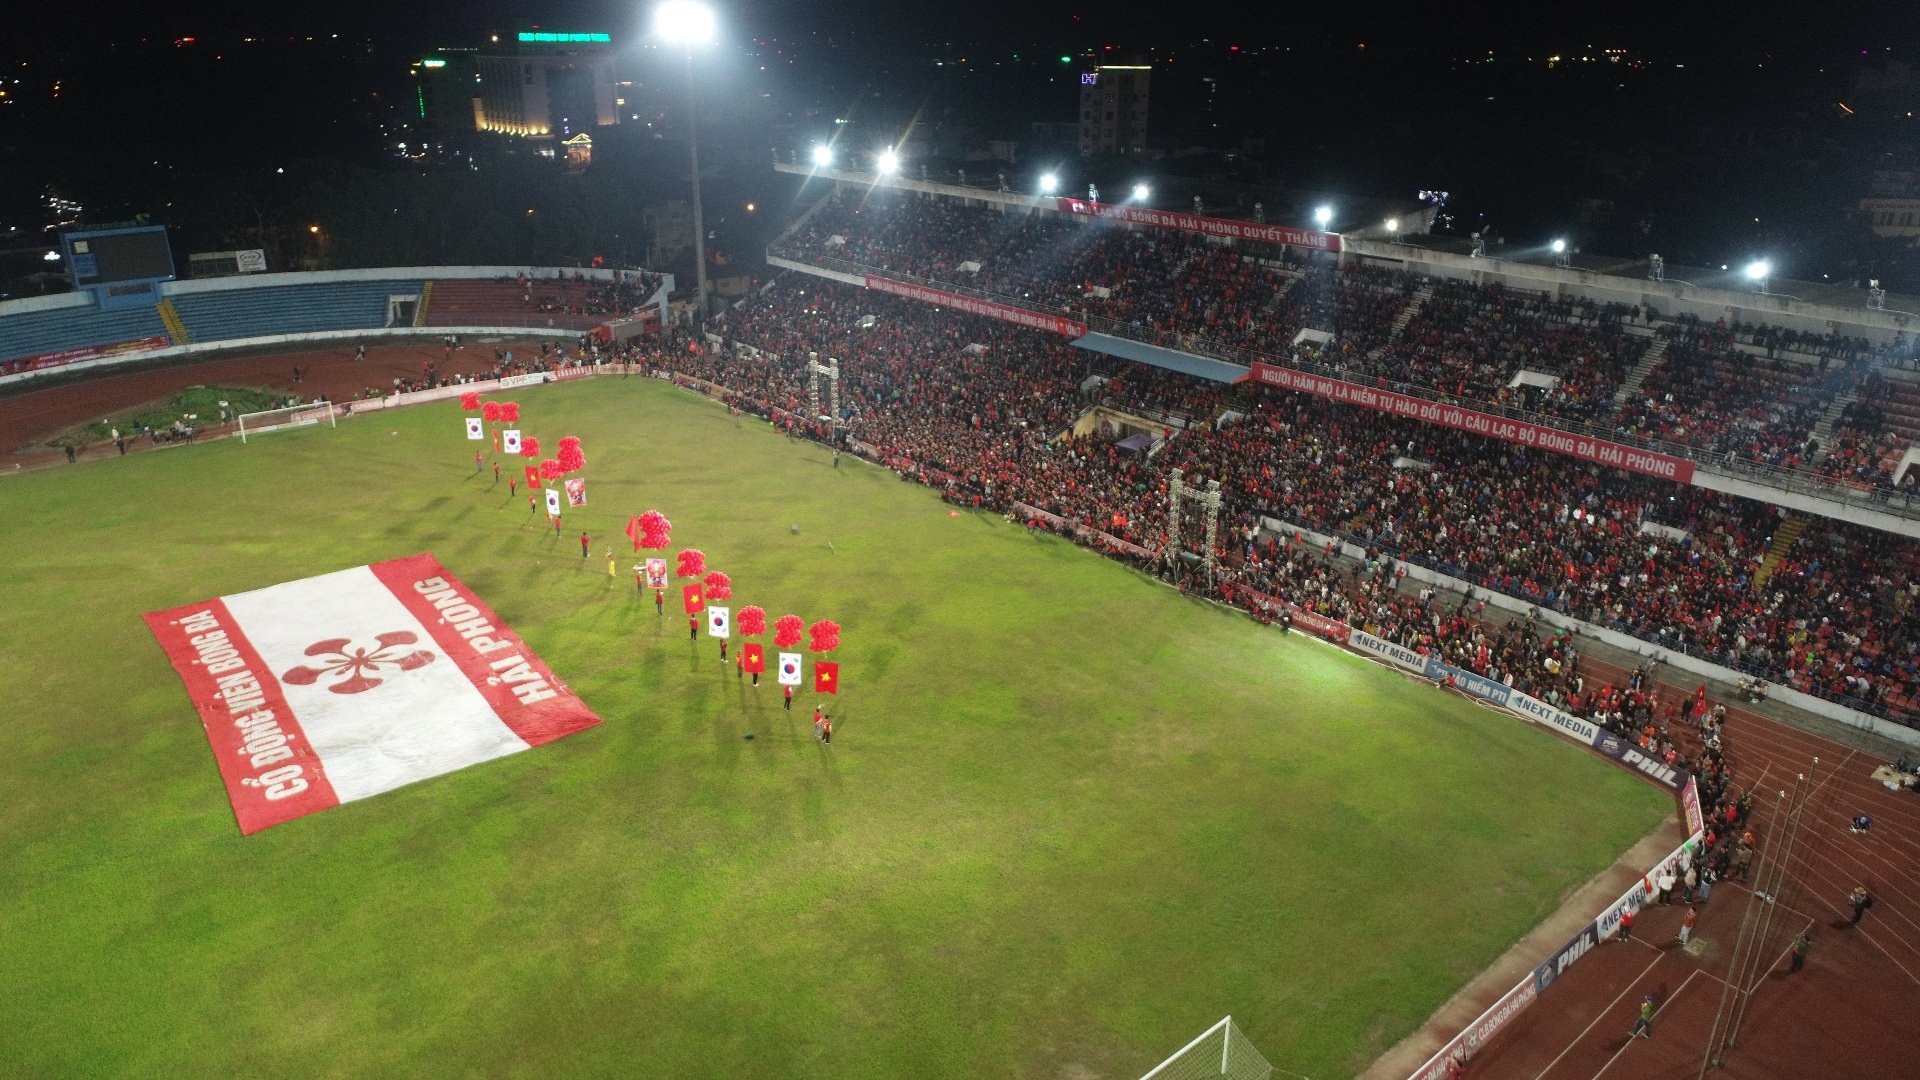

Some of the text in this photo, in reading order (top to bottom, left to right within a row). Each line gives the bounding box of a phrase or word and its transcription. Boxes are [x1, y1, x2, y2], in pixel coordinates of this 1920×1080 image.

[1094, 206, 1112, 218] LẠC
[1115, 208, 1128, 220] BỘ
[1132, 210, 1159, 224] BÓNG
[1161, 213, 1177, 226] ĐÁ
[1180, 216, 1198, 229] HẢI
[1201, 221, 1240, 235] PHÒNG
[1243, 226, 1281, 241] QUYẾT
[1285, 230, 1327, 247] THẮNG
[921, 291, 940, 303] CHUNG
[940, 295, 950, 305] TAY
[987, 306, 1001, 318] PHÁT
[1003, 308, 1019, 321] TRIỂN
[1020, 312, 1037, 325] BÓNG
[1038, 317, 1046, 327] ĐÁ
[510, 375, 527, 386] VPF
[1261, 369, 1676, 477] NGƯỜI HÂM MỘ LÀ NIỀM TỰ HÀO ĐỐI VỚI CÂU LẠC BỘ BÓNG ĐÁ HẢI PHÒNG
[413, 575, 558, 706] HẢI PHÒNG
[1361, 636, 1423, 668] NEXT MEDIA
[170, 609, 309, 801] CỔ ĐỘNG VIÊN BÓNG ĐÁ
[1467, 679, 1491, 697] HIỂM
[1491, 688, 1509, 703] PTI
[1522, 700, 1594, 739] NEXT MEDIA
